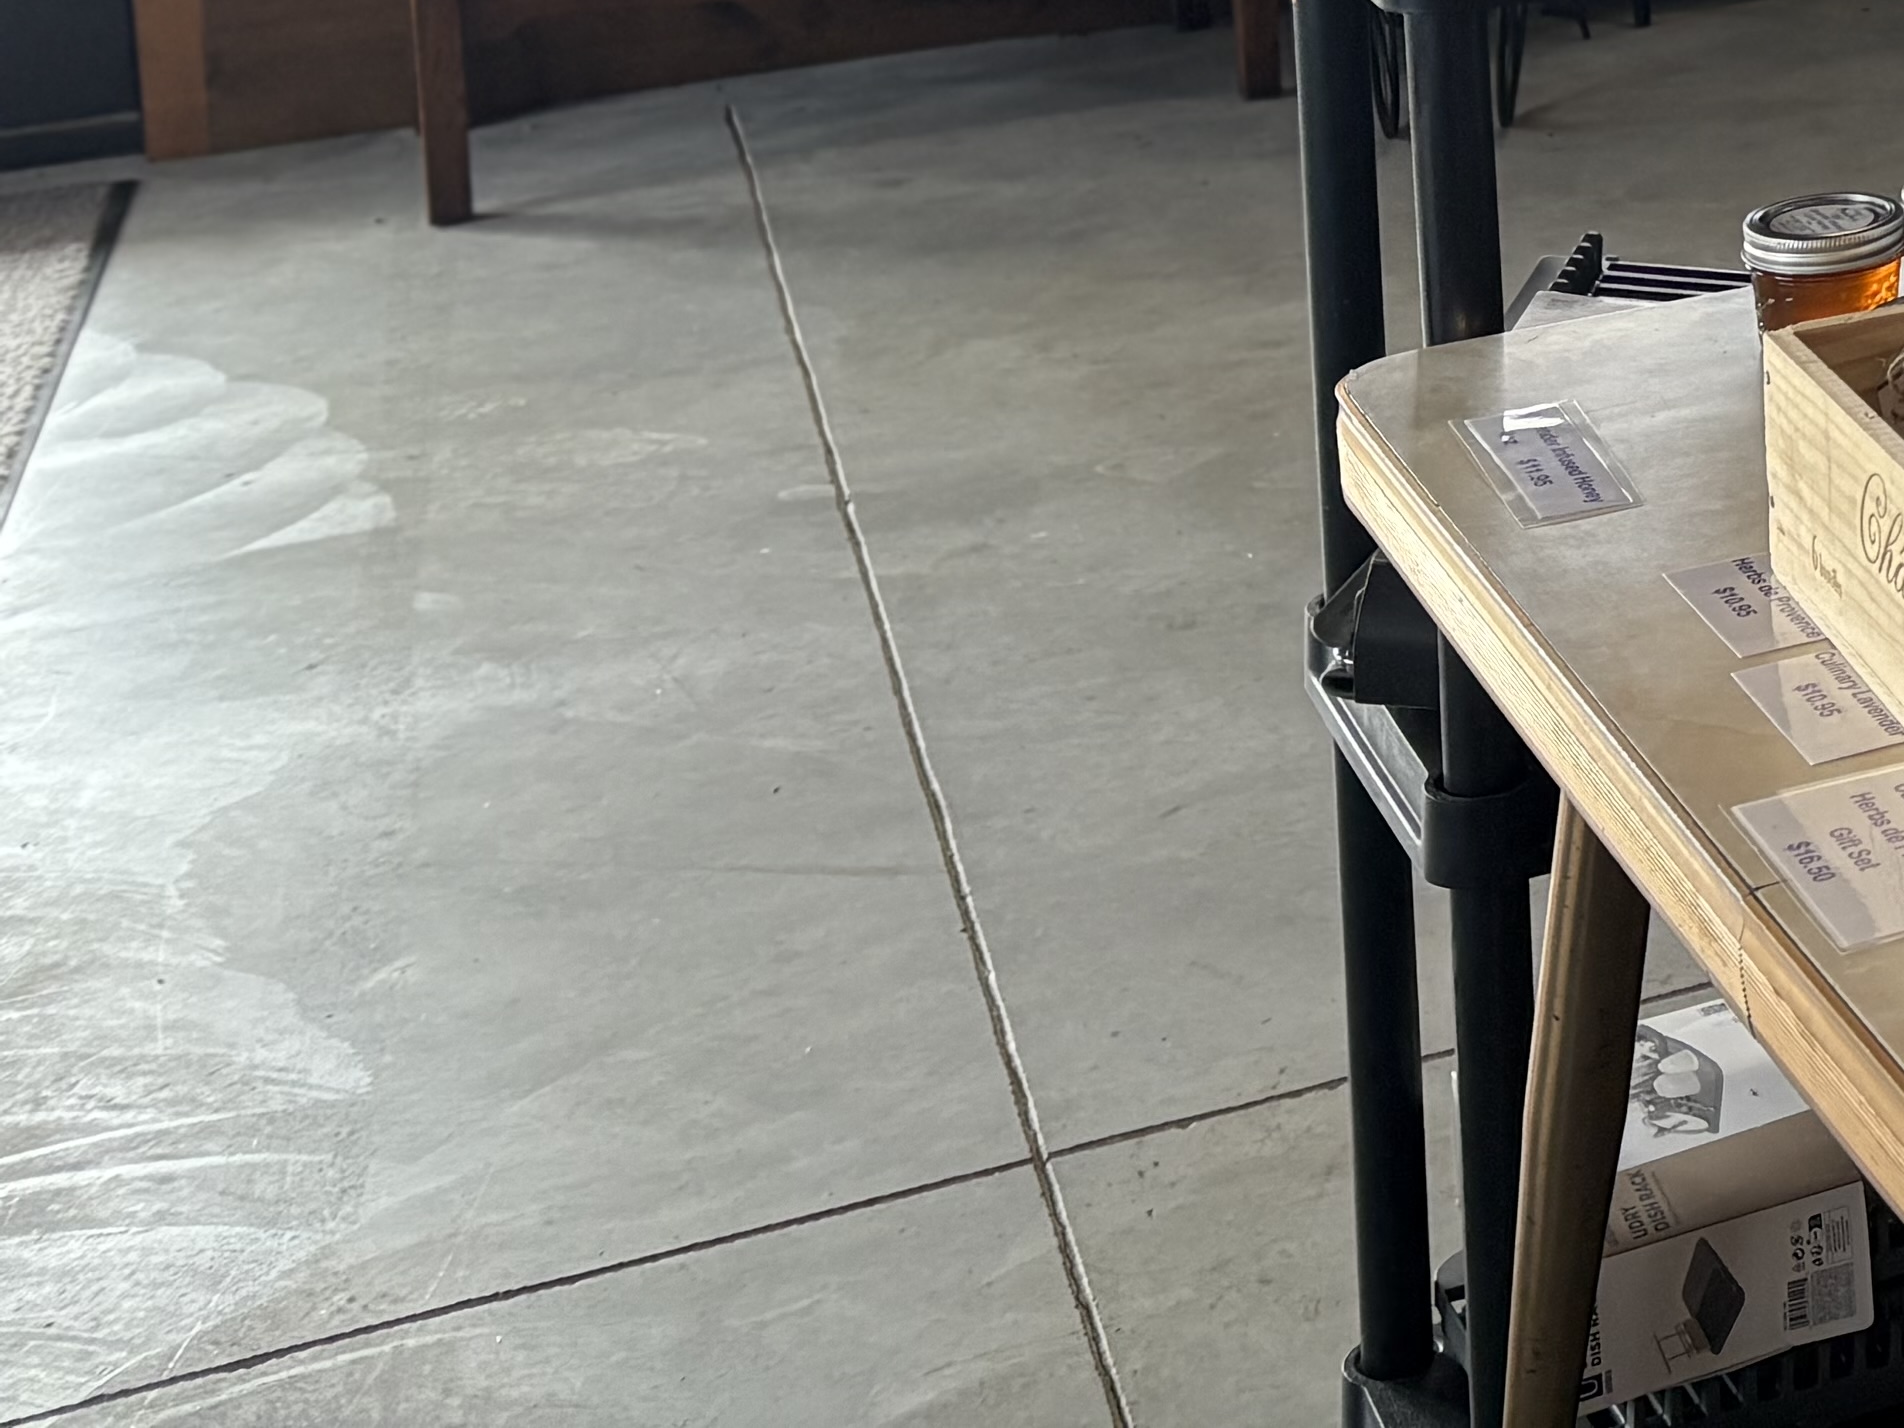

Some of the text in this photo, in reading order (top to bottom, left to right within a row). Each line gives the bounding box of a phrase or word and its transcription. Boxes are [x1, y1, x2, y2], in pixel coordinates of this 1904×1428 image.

[1712, 586, 1758, 618] $10.95
[1731, 557, 1821, 639] Herbs de Provence
[1814, 651, 1862, 695] Culinary
[1792, 682, 1842, 718] $10.95
[1850, 791, 1893, 830] Herbs
[1881, 825, 1904, 846] de
[1785, 840, 1837, 883] $16.50
[1830, 826, 1881, 872] Gift Set
[1621, 1205, 1648, 1240] UDRY
[1643, 1201, 1671, 1232] DISH
